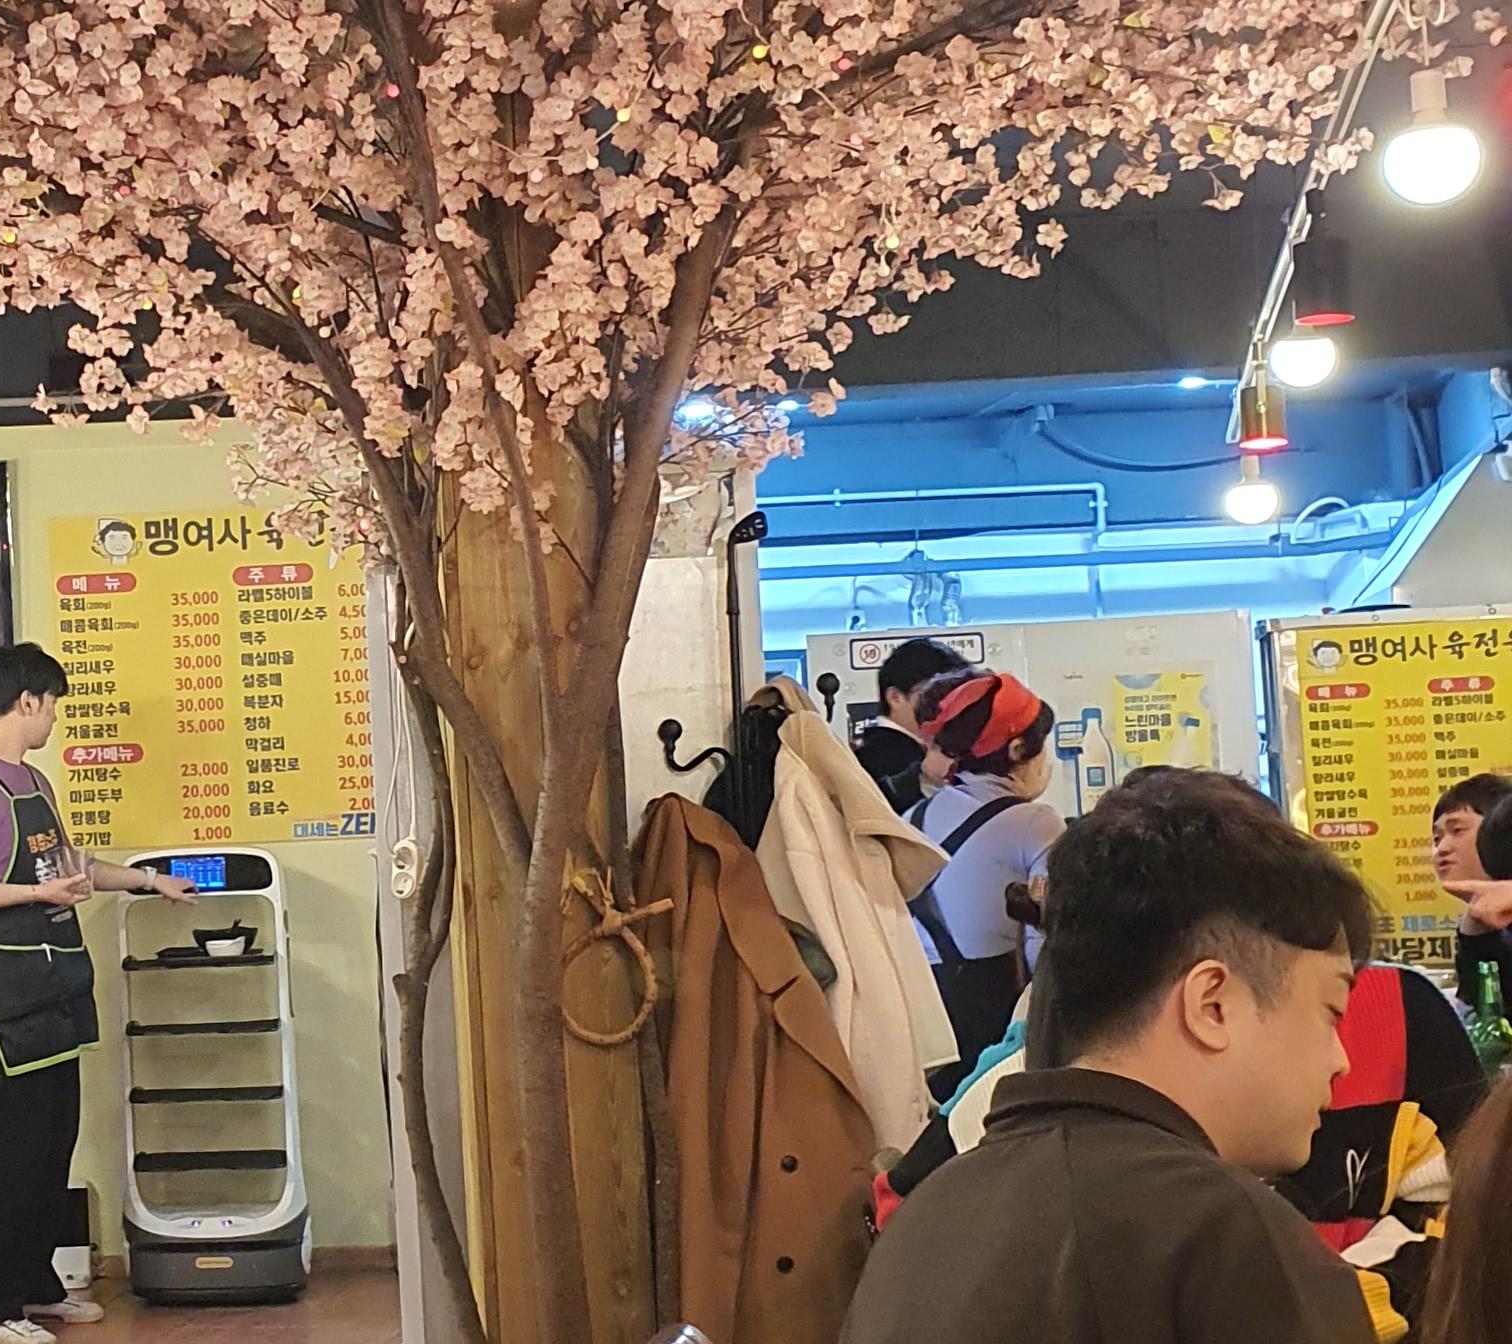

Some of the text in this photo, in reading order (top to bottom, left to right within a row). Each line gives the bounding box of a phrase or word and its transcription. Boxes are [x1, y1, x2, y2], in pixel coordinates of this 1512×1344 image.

[144, 516, 252, 556] 맹여사
[171, 591, 219, 607] 35,000
[172, 612, 220, 628] 35,000
[239, 606, 328, 624] 좋은데이/소주
[173, 633, 221, 649] 35,000
[240, 631, 267, 645] 맥주
[241, 650, 294, 666] 매실마을
[1349, 634, 1438, 666] 맹여사
[174, 655, 222, 670] 30,000
[175, 676, 223, 692] 30,000
[242, 673, 282, 688] 설중매
[64, 697, 224, 718] 찹쌀탕수육 30,000
[243, 694, 284, 709] 복분자
[1384, 696, 1424, 709] 35,000
[244, 716, 271, 731] 청하
[1124, 713, 1172, 728] 느린마을
[1386, 714, 1425, 727] 35,000
[65, 719, 225, 739] 겨울굴전 35,000
[245, 736, 285, 752] 막걸리
[1387, 732, 1426, 745] 35,000
[72, 746, 134, 763] 추가메뉴
[1389, 750, 1428, 763] 30,000
[69, 762, 229, 783] 가지탕수 23,000
[246, 757, 300, 773] 일품진로
[1390, 768, 1429, 781] 30,000
[70, 783, 230, 804] 마파두부 20,000
[247, 780, 275, 794] 화요
[1391, 786, 1430, 799] 30,000
[71, 805, 231, 826] 짬뽕탕 20,000
[249, 801, 289, 816] 음료수
[1392, 804, 1431, 817] 35,000
[72, 831, 112, 847] 공기밥
[193, 826, 232, 841] 1,000
[1328, 840, 1361, 852] 지탕수
[1401, 914, 1463, 933] 제로소
